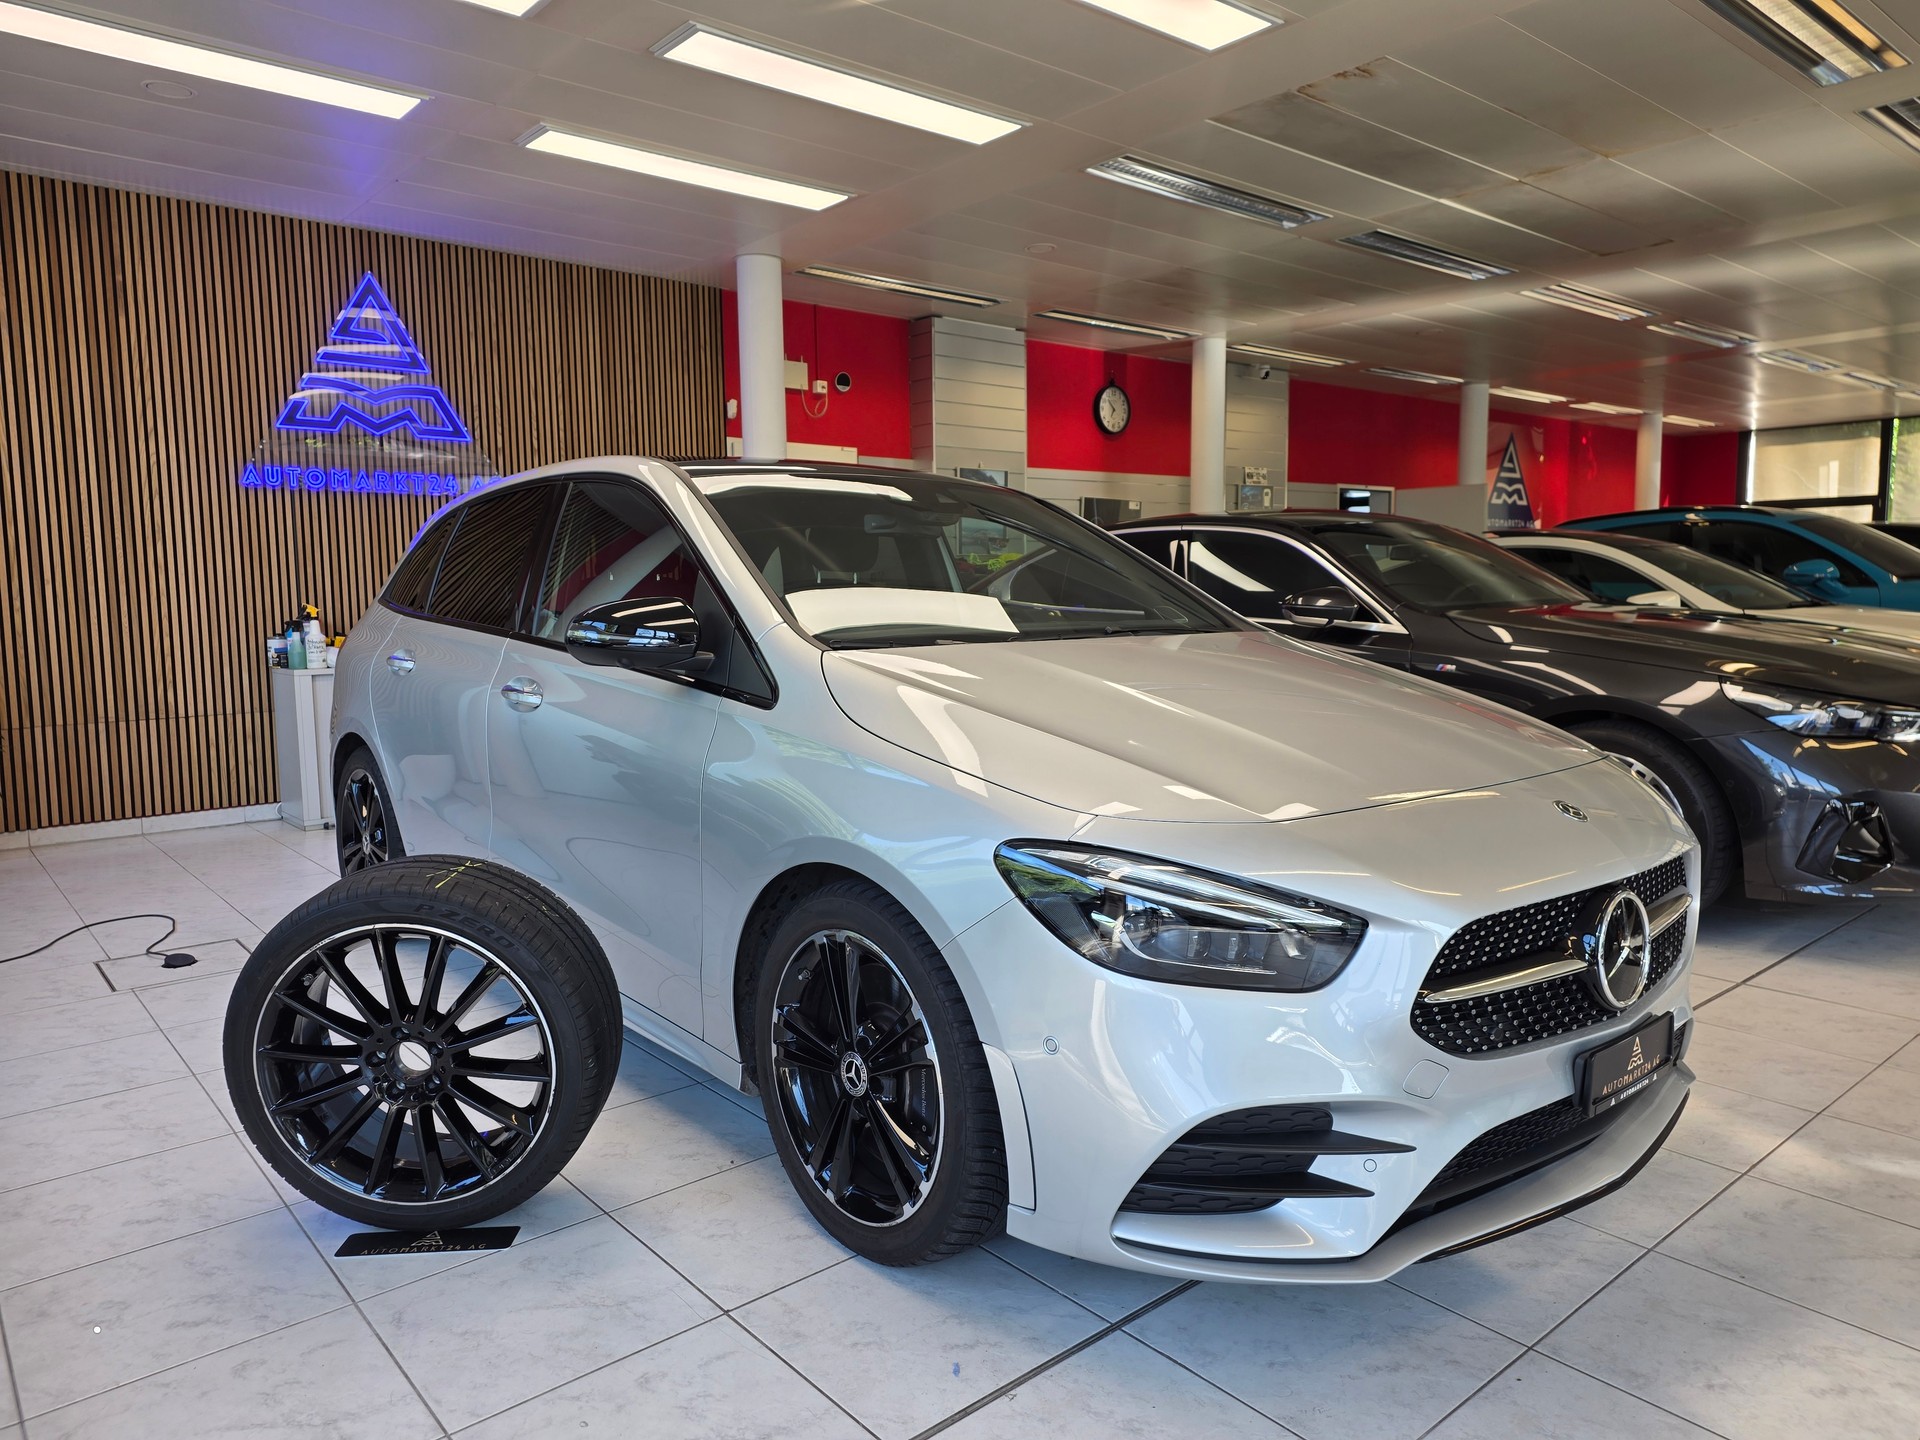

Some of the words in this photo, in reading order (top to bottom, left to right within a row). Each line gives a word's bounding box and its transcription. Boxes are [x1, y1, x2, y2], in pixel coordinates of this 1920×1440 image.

[242, 464, 459, 495] AUTOMARKT24
[1487, 518, 1525, 529] UTOMARKT24
[414, 903, 435, 913] P
[439, 908, 514, 949] ZERO
[1602, 1061, 1651, 1096] AUTOMARKT24
[1652, 1054, 1660, 1068] AG
[1620, 1078, 1649, 1100] AUTOMARKT24
[360, 1244, 461, 1255] AUTOMARKT24
